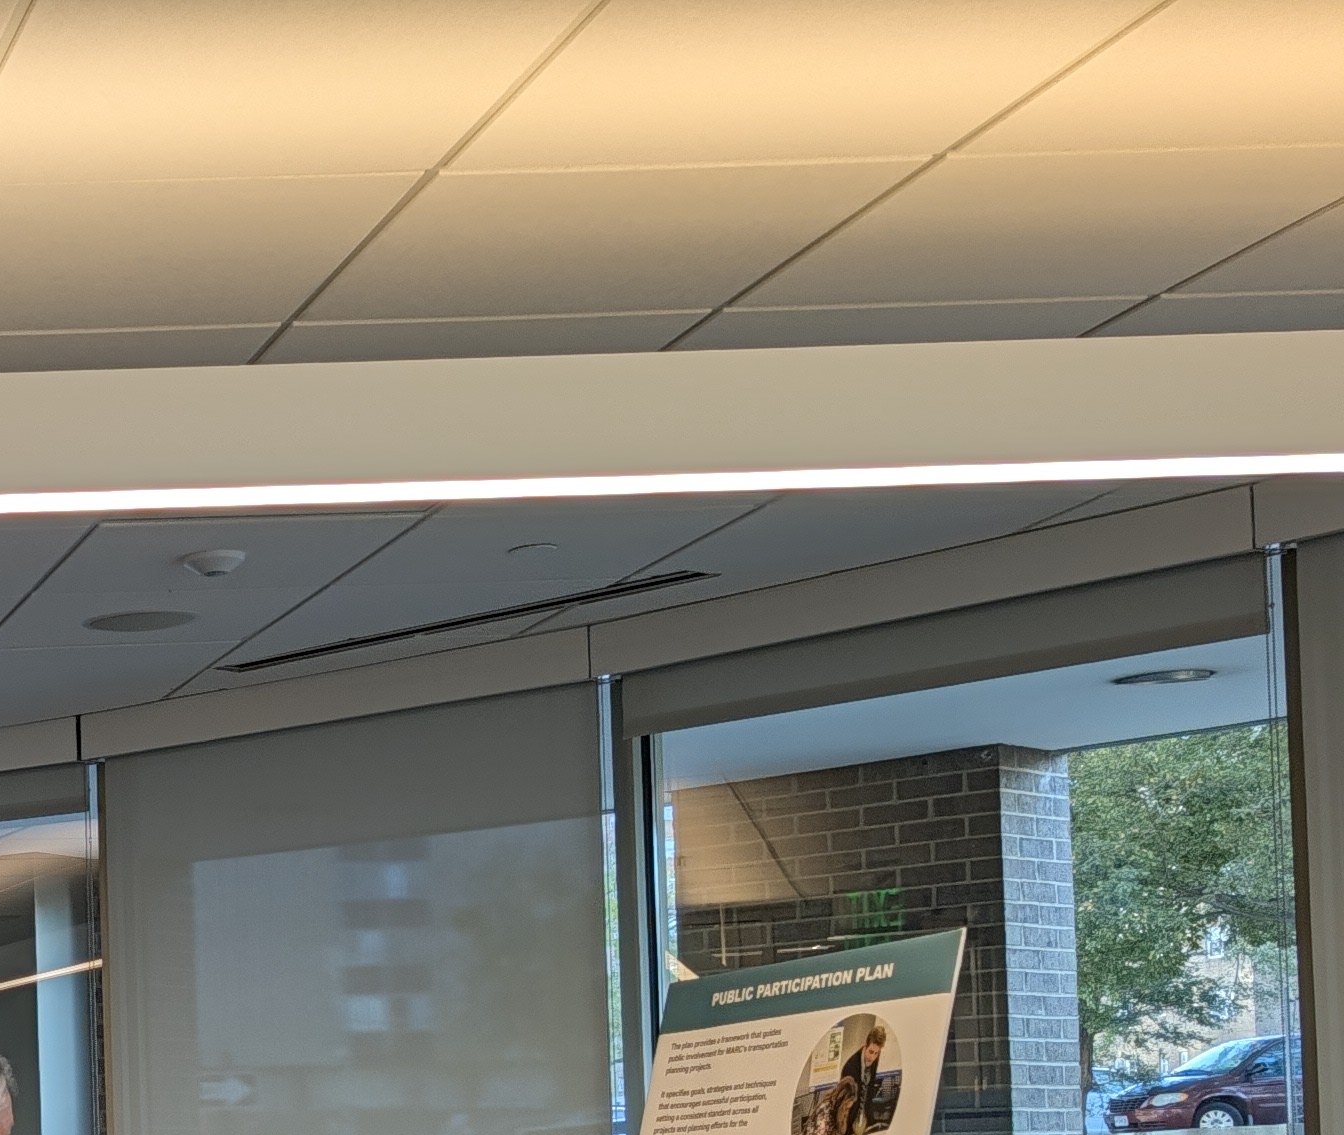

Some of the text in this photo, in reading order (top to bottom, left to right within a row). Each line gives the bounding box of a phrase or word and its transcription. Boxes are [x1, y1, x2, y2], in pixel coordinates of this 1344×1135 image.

[712, 963, 894, 1007] PUBLIC PARTICIPATION PLAN
[682, 1042, 693, 1050] plan
[694, 1039, 716, 1048] provides
[721, 1032, 749, 1043] framework
[763, 1029, 781, 1039] guides
[668, 1054, 685, 1064] public
[686, 1050, 716, 1060] involvement
[726, 1045, 747, 1054] MARC's
[748, 1041, 788, 1052] transportation
[666, 1066, 688, 1076] planning
